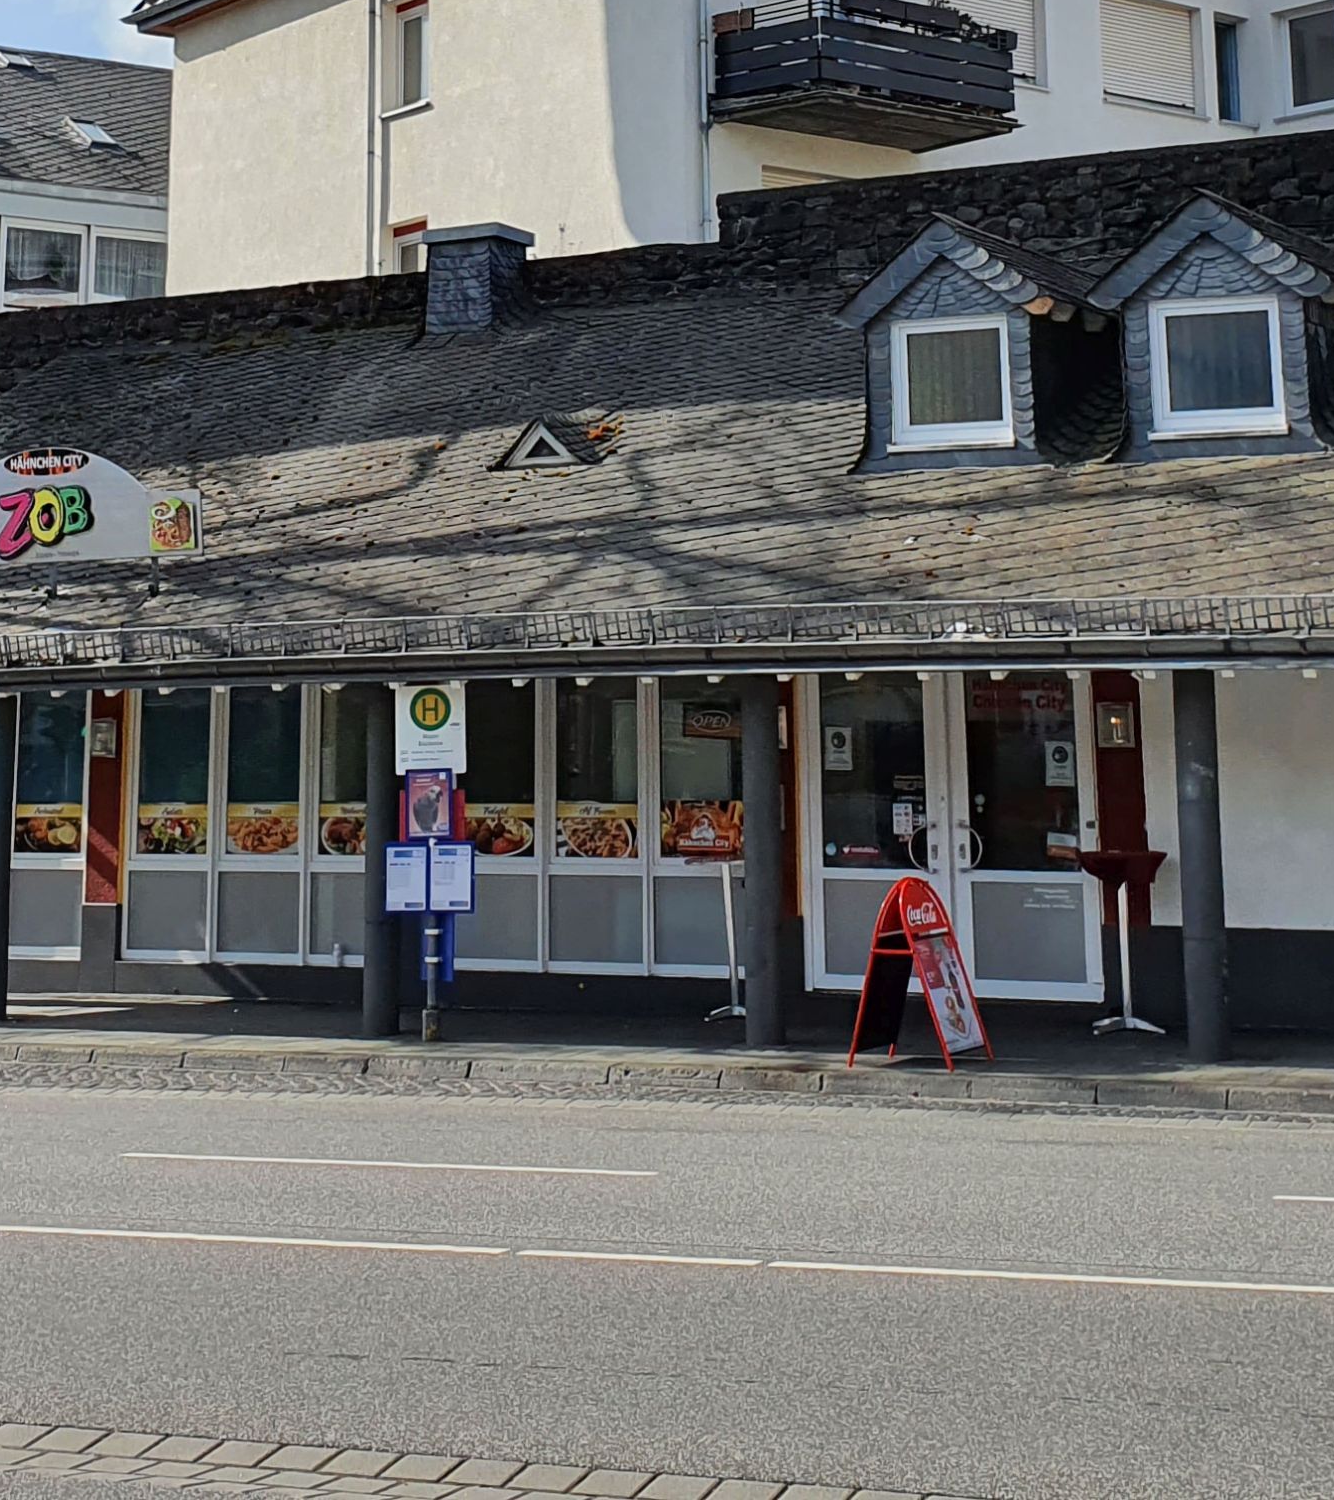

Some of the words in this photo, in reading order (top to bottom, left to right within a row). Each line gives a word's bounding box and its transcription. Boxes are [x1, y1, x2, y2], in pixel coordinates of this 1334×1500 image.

[10, 455, 62, 470] HÄHNCHEN
[62, 453, 84, 467] CITY
[422, 698, 439, 721] H
[1036, 695, 1066, 712] City
[693, 715, 730, 728] OPEN
